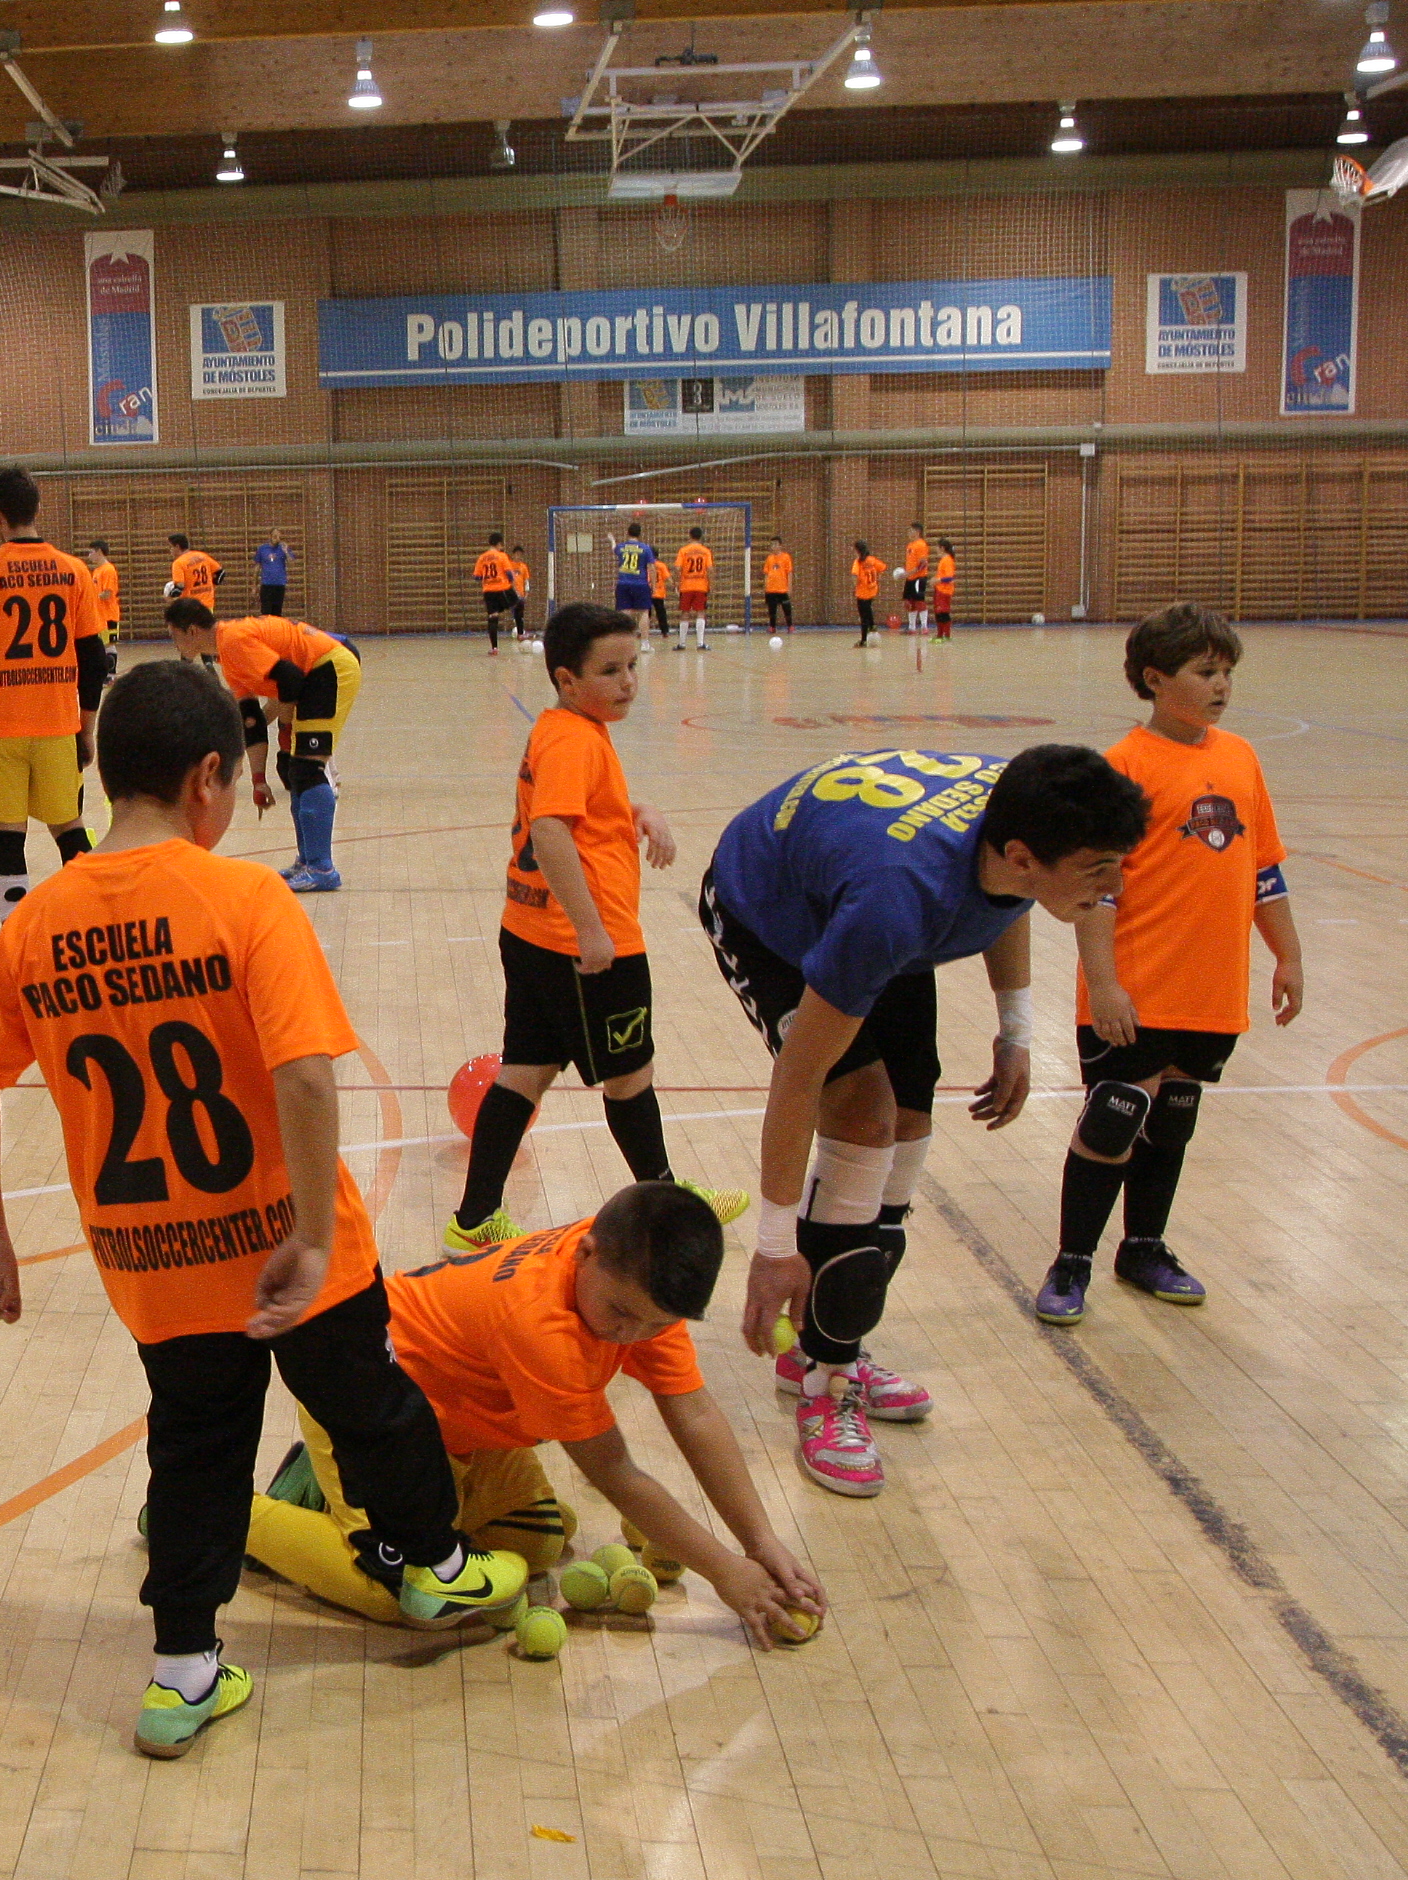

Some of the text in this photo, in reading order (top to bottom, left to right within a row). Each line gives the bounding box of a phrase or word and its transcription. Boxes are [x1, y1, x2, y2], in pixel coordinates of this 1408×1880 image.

[407, 300, 1022, 363] Polideportivo Villafontana
[1158, 328, 1236, 341] AYUNTAMIENTO
[1158, 343, 1173, 357] DE
[202, 354, 276, 368] AYUNTAMIENTO
[203, 371, 218, 384] DE
[7, 560, 57, 574] ESCUELA
[622, 552, 639, 570] 28
[687, 557, 703, 574] 28
[28, 572, 76, 587] SEDANO
[192, 565, 208, 588] 28
[2, 593, 68, 660] 28
[886, 780, 985, 843] SEDANO
[52, 916, 174, 973] ESCUELA
[22, 953, 233, 1019] PACO SEDANO
[65, 1020, 255, 1207] 28
